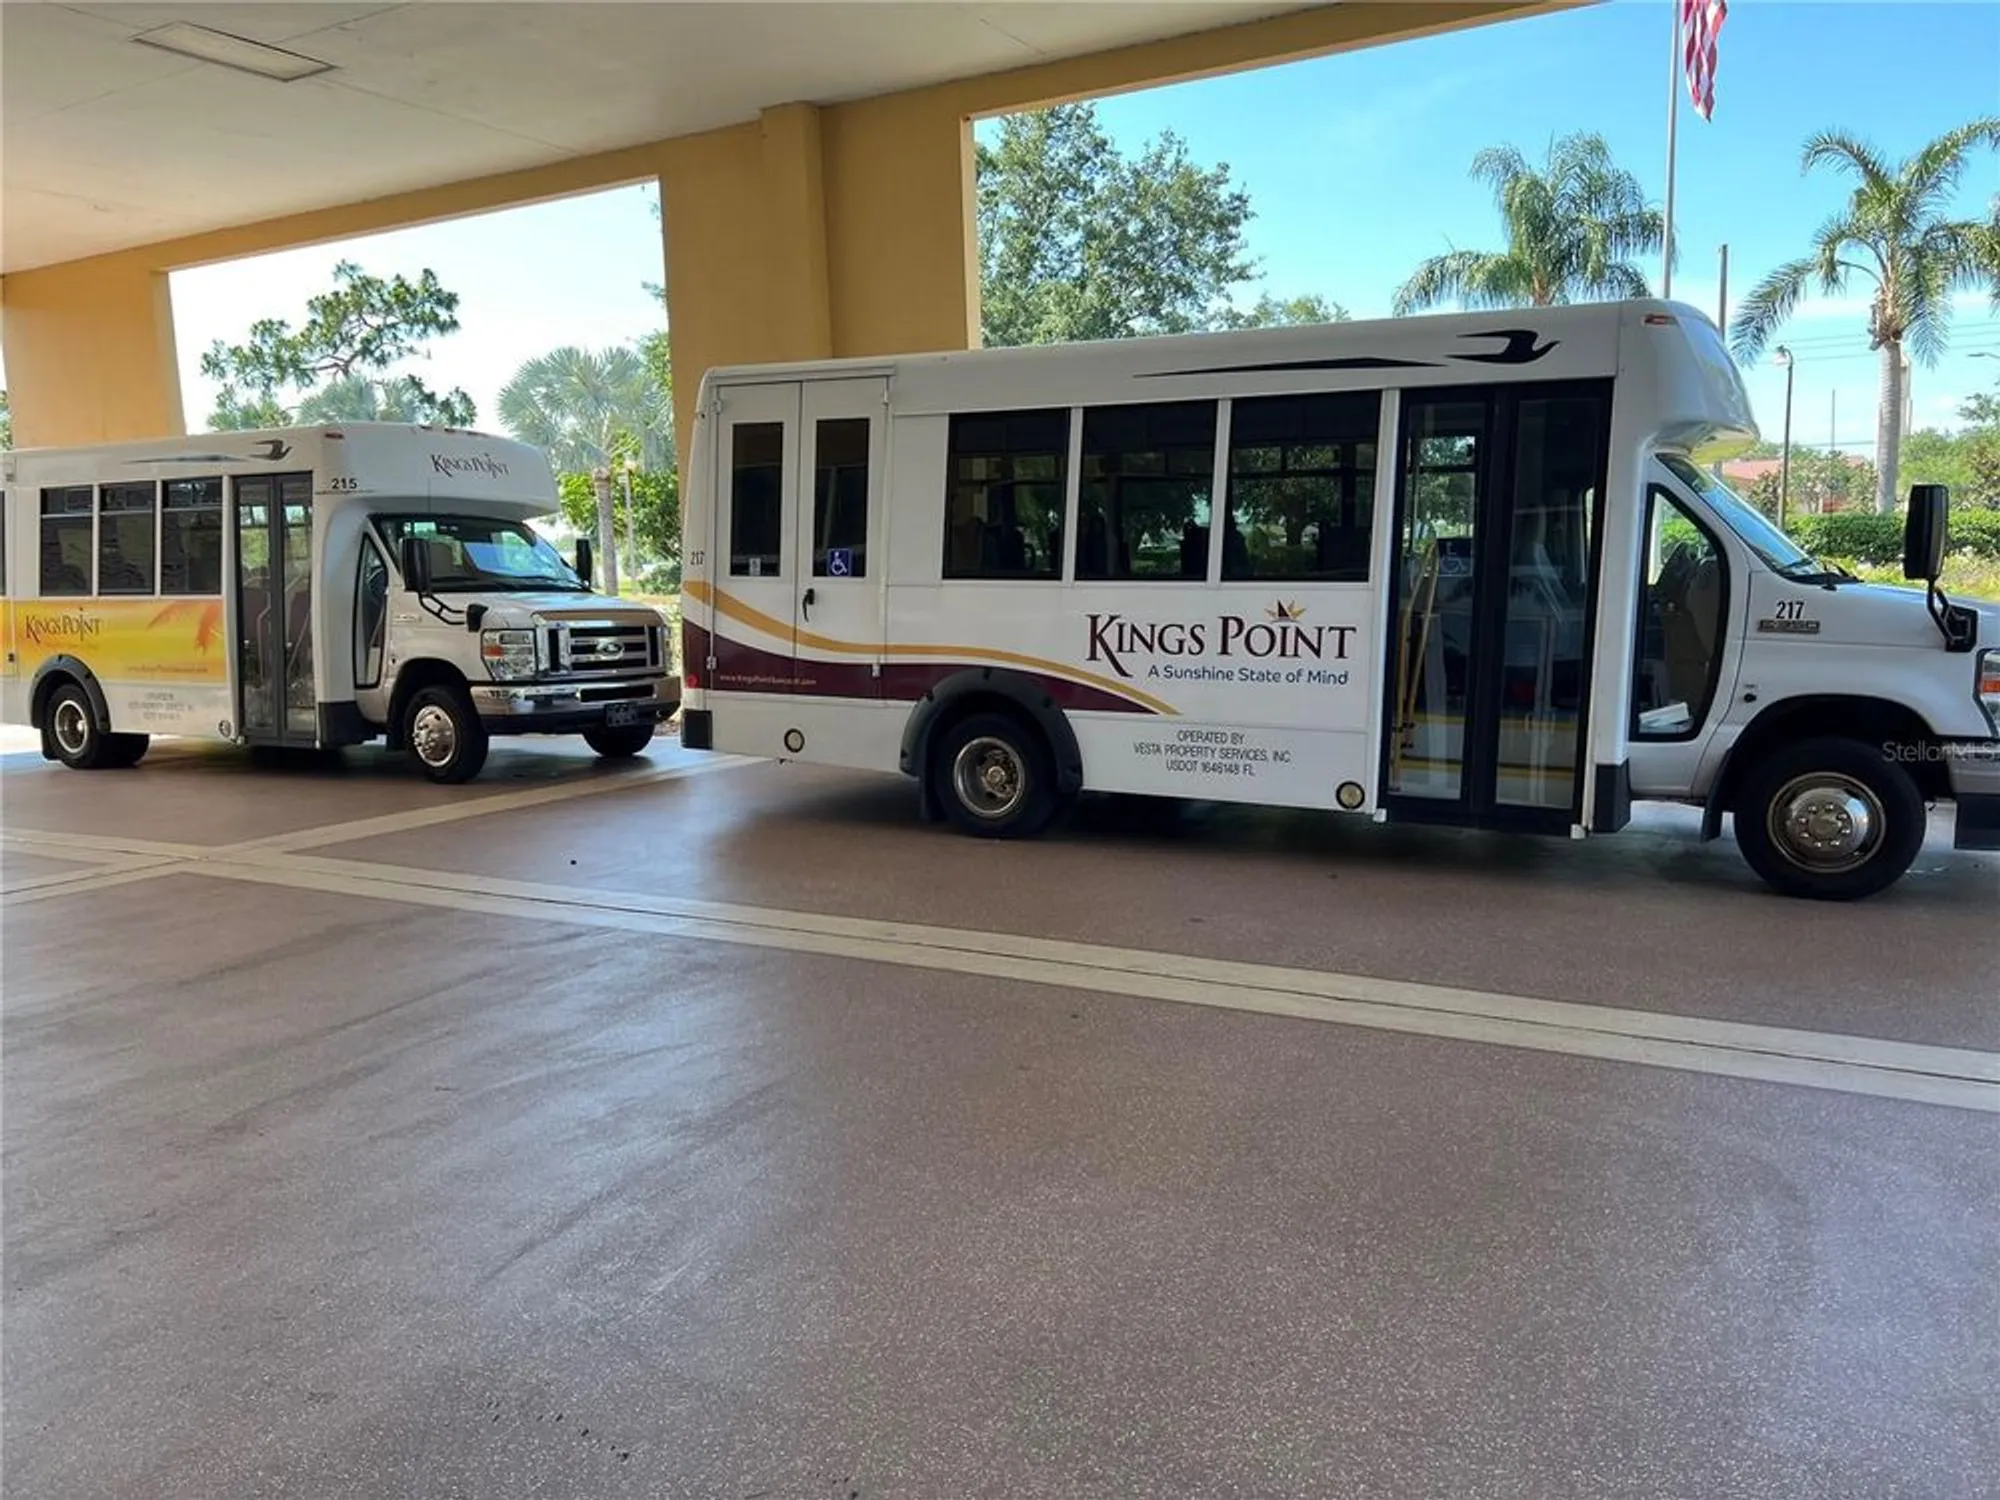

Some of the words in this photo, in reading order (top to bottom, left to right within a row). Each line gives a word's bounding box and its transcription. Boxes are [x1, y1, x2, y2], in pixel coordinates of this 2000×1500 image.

[331, 477, 358, 490] 215
[690, 551, 705, 566] 217
[1775, 600, 1805, 620] 217
[1085, 613, 1206, 678] KINGS
[1217, 614, 1357, 660] POINT
[1148, 664, 1160, 679] A
[1163, 665, 1235, 682] Sunshine
[1238, 667, 1282, 683] State
[1285, 668, 1303, 683] of
[1307, 669, 1350, 686] Mind
[1176, 730, 1227, 745] OPERATED
[1230, 732, 1245, 745] BY
[1133, 742, 1162, 756] VESTA
[1164, 744, 1217, 758] PROPERTY
[1166, 759, 1198, 773] USDOT
[1243, 763, 1256, 776] FL
